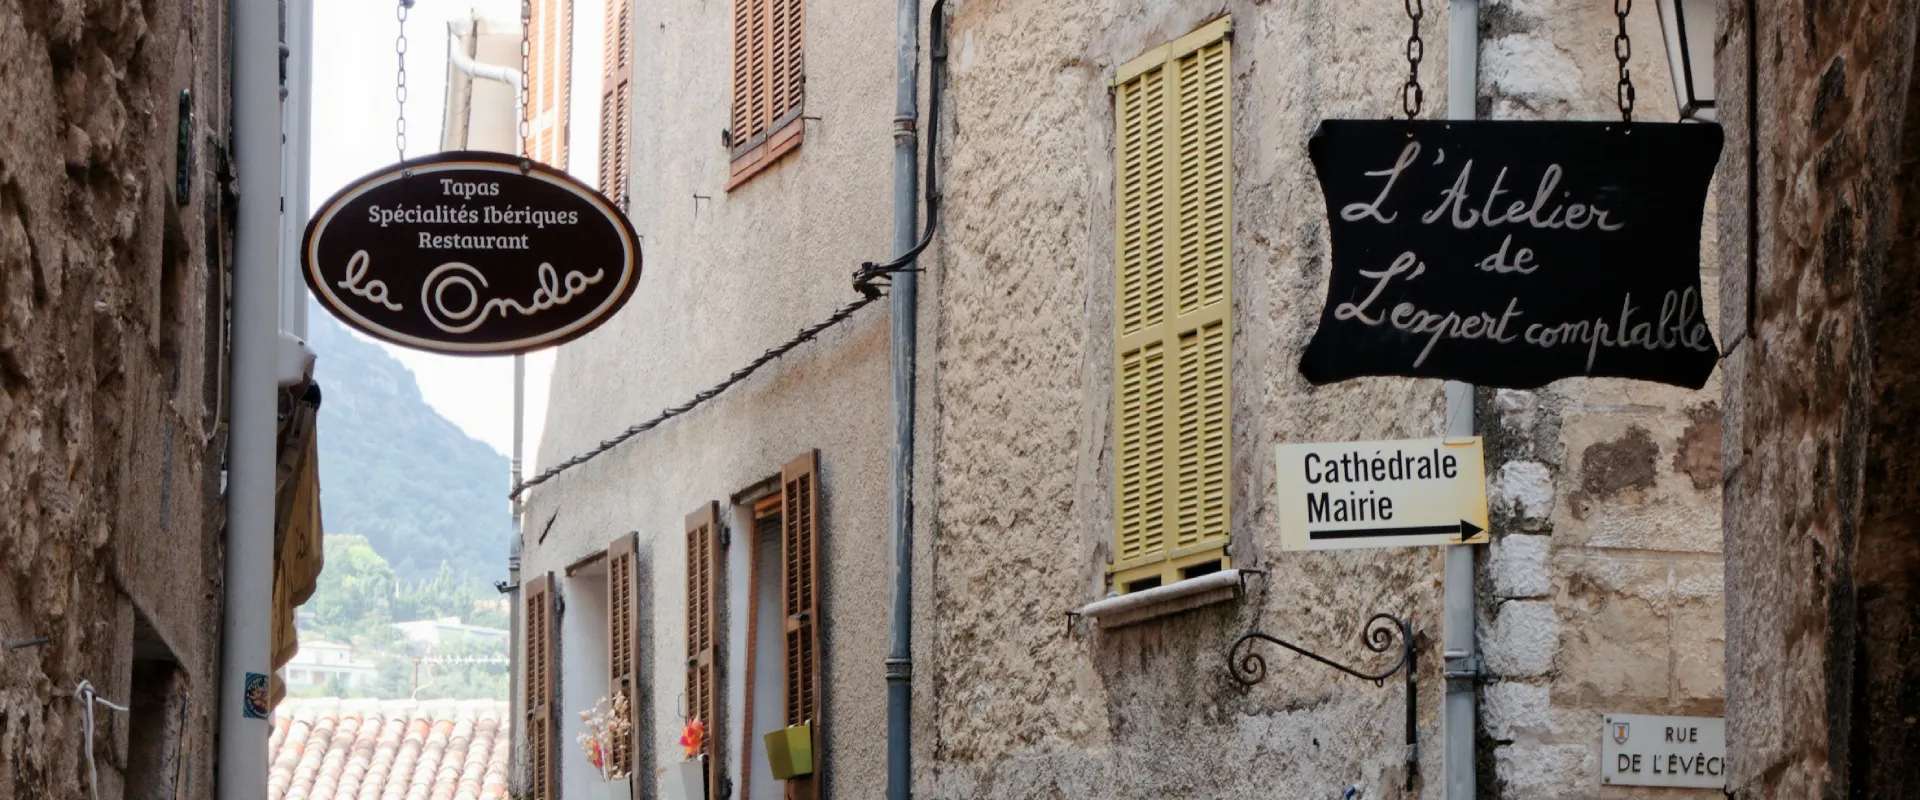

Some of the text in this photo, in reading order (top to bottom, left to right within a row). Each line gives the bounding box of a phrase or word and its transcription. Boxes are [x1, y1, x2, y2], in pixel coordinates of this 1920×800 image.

[440, 179, 500, 199] Tapas
[1340, 141, 1625, 231] L'Atelier
[368, 204, 579, 229] Spécialités Ibériques
[418, 232, 529, 250] Restaurant
[1474, 234, 1539, 274] de
[337, 249, 605, 334] la Onda
[1335, 250, 1711, 374] L'expert comptable
[1304, 448, 1458, 484] Cathédrale
[1306, 490, 1393, 523] Mairie
[1665, 726, 1698, 743] RUE
[1617, 753, 1642, 773] DE
